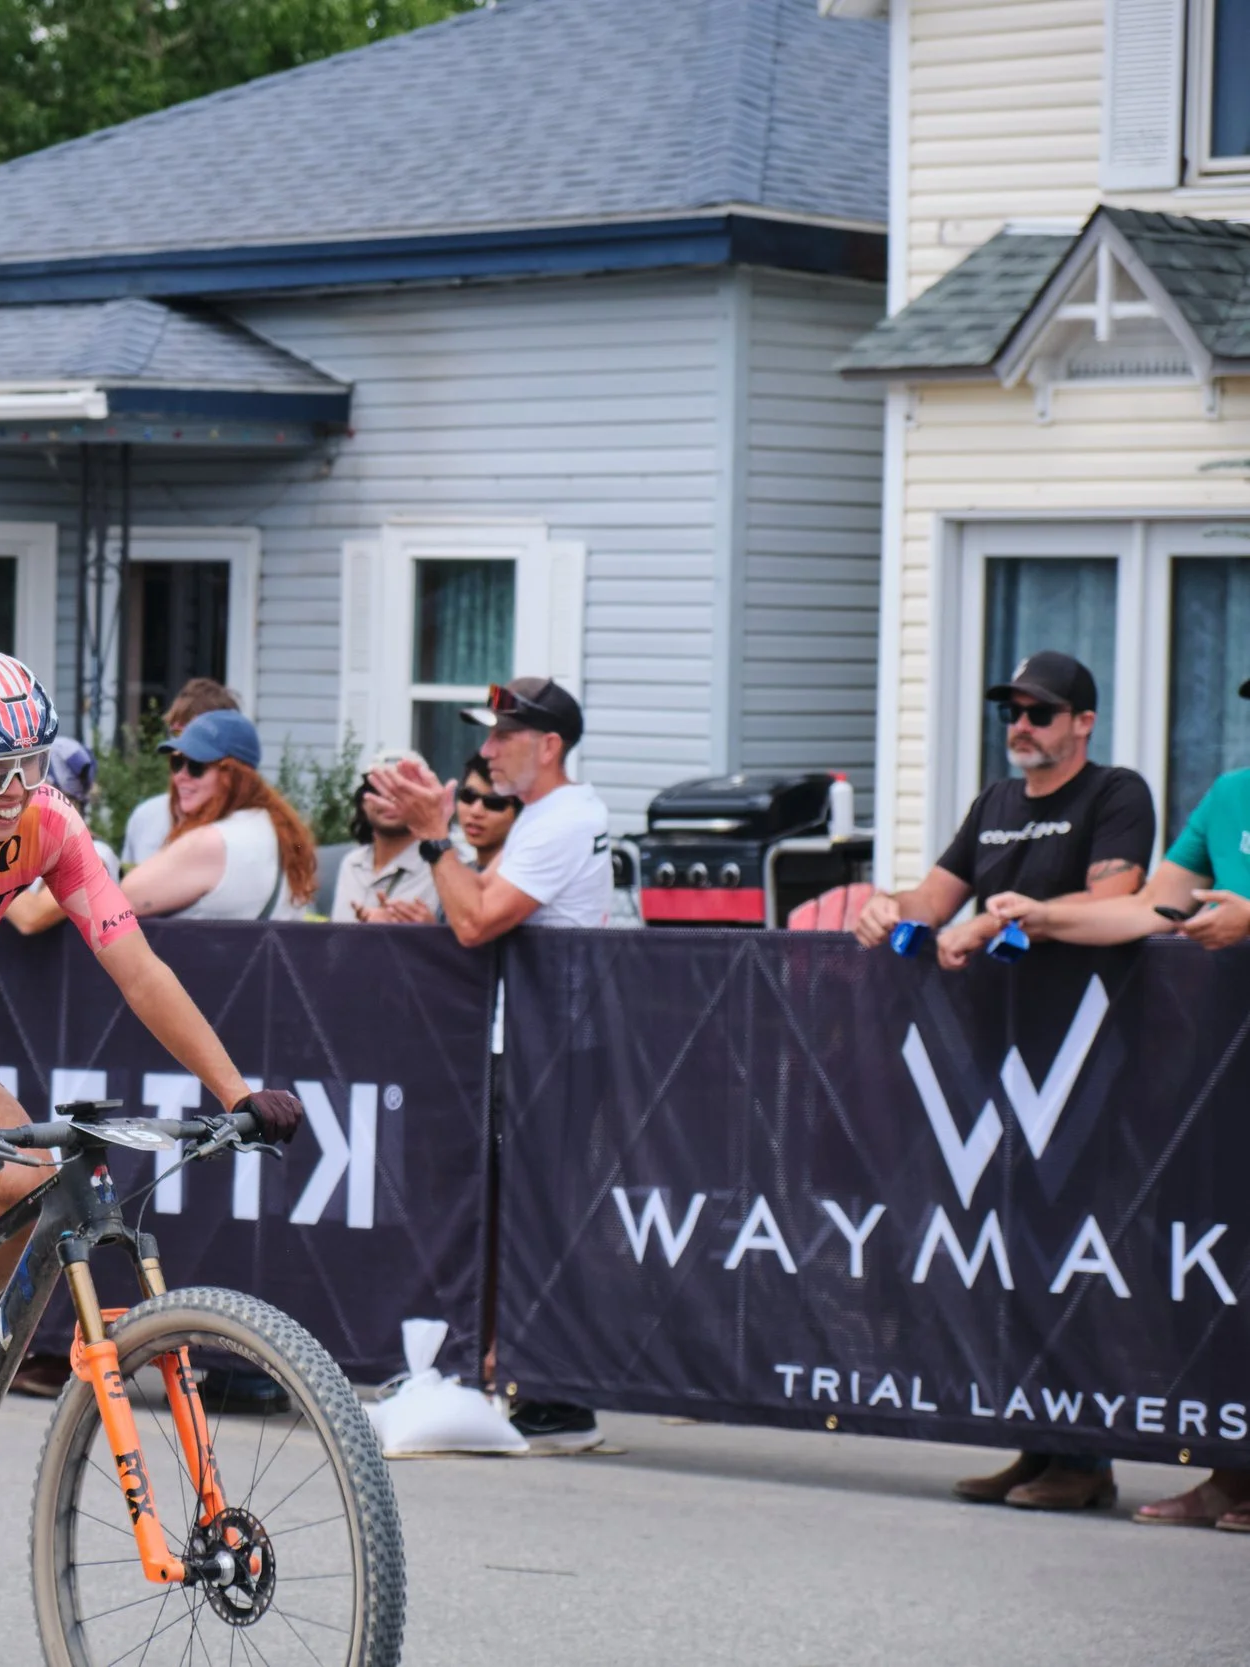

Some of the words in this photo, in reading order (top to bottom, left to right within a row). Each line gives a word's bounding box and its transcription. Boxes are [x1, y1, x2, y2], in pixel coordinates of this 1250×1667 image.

[612, 1186, 1238, 1306] WAYMAK
[774, 1363, 938, 1412] TRIAL
[970, 1381, 1249, 1441] LAWYERS
[114, 1449, 155, 1526] FOX
